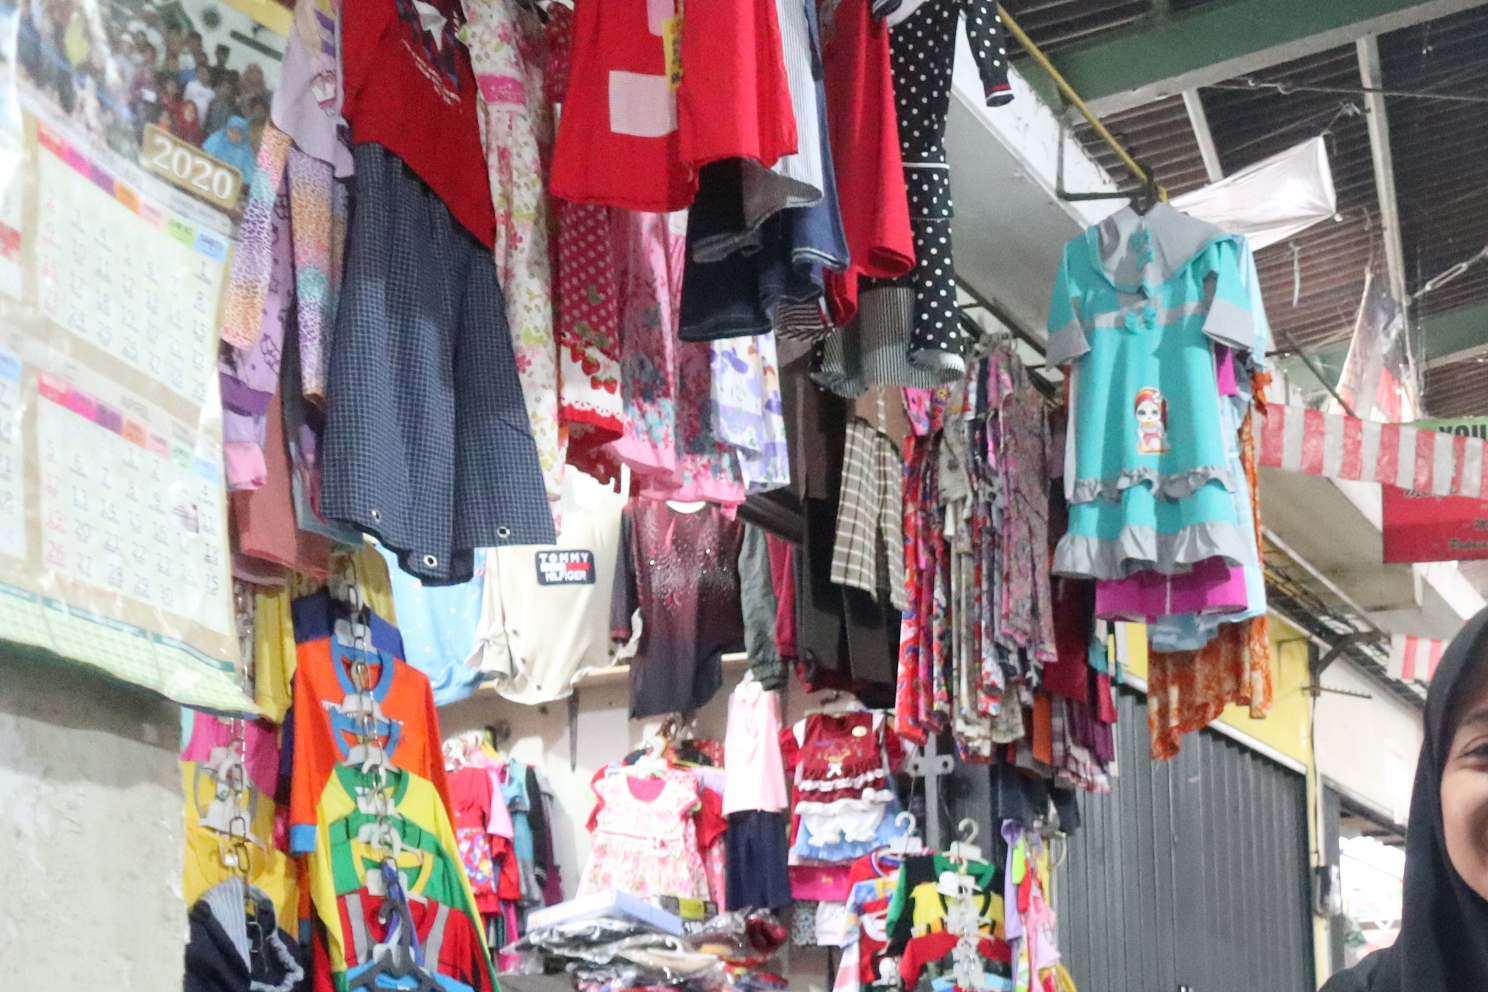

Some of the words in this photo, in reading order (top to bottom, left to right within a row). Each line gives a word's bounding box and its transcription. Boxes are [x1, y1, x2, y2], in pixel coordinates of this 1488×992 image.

[152, 135, 234, 200] 2020
[539, 552, 589, 563] TOMMY
[545, 570, 587, 582] HILFIGER
